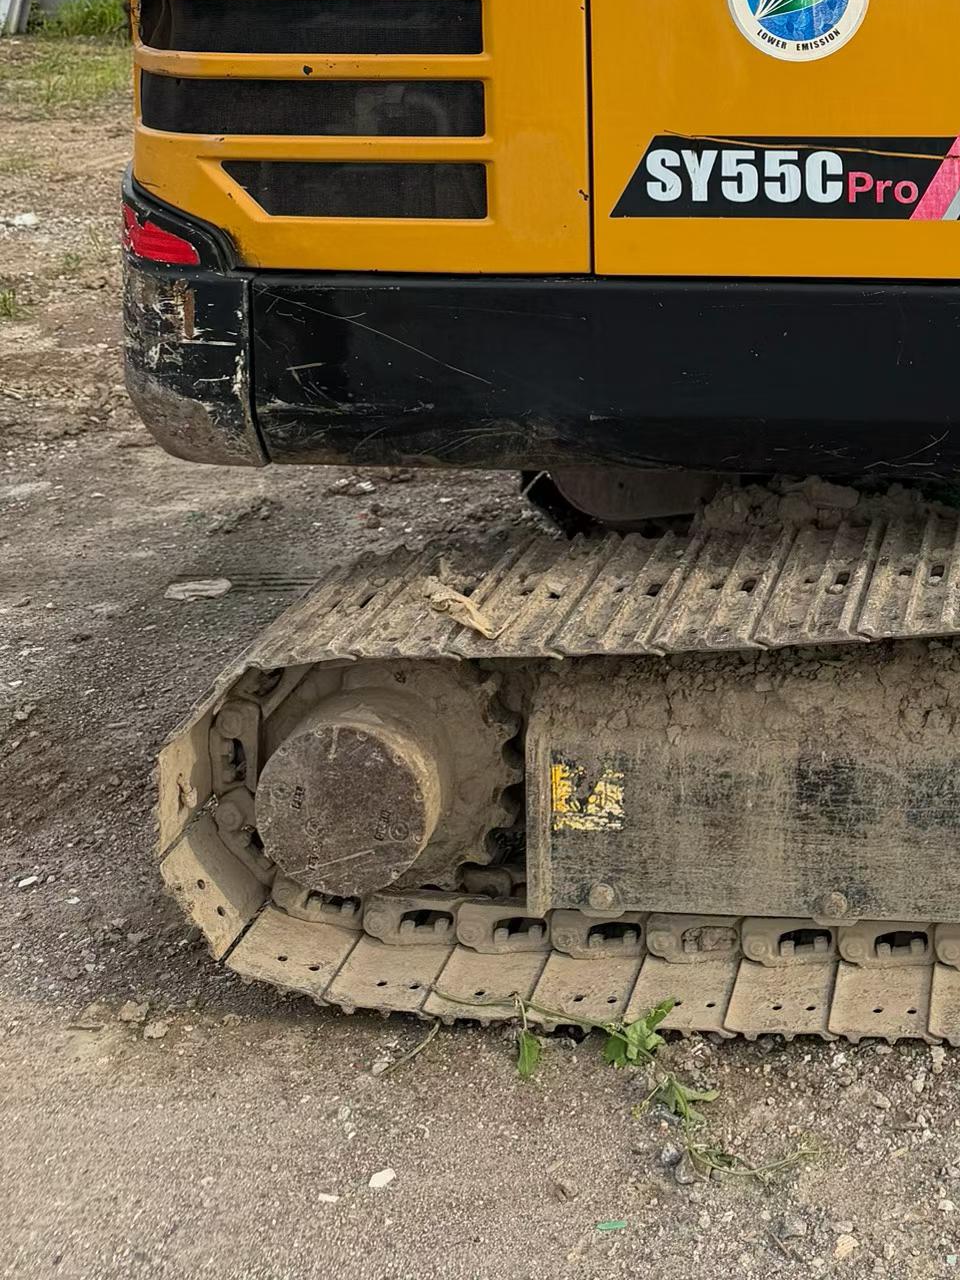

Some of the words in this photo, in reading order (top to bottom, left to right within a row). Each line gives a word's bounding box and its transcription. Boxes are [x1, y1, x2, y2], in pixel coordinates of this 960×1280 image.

[757, 29, 787, 50] LOWER
[796, 28, 841, 51] EMISSION
[645, 149, 843, 204] SY55C
[848, 171, 920, 204] Pro
